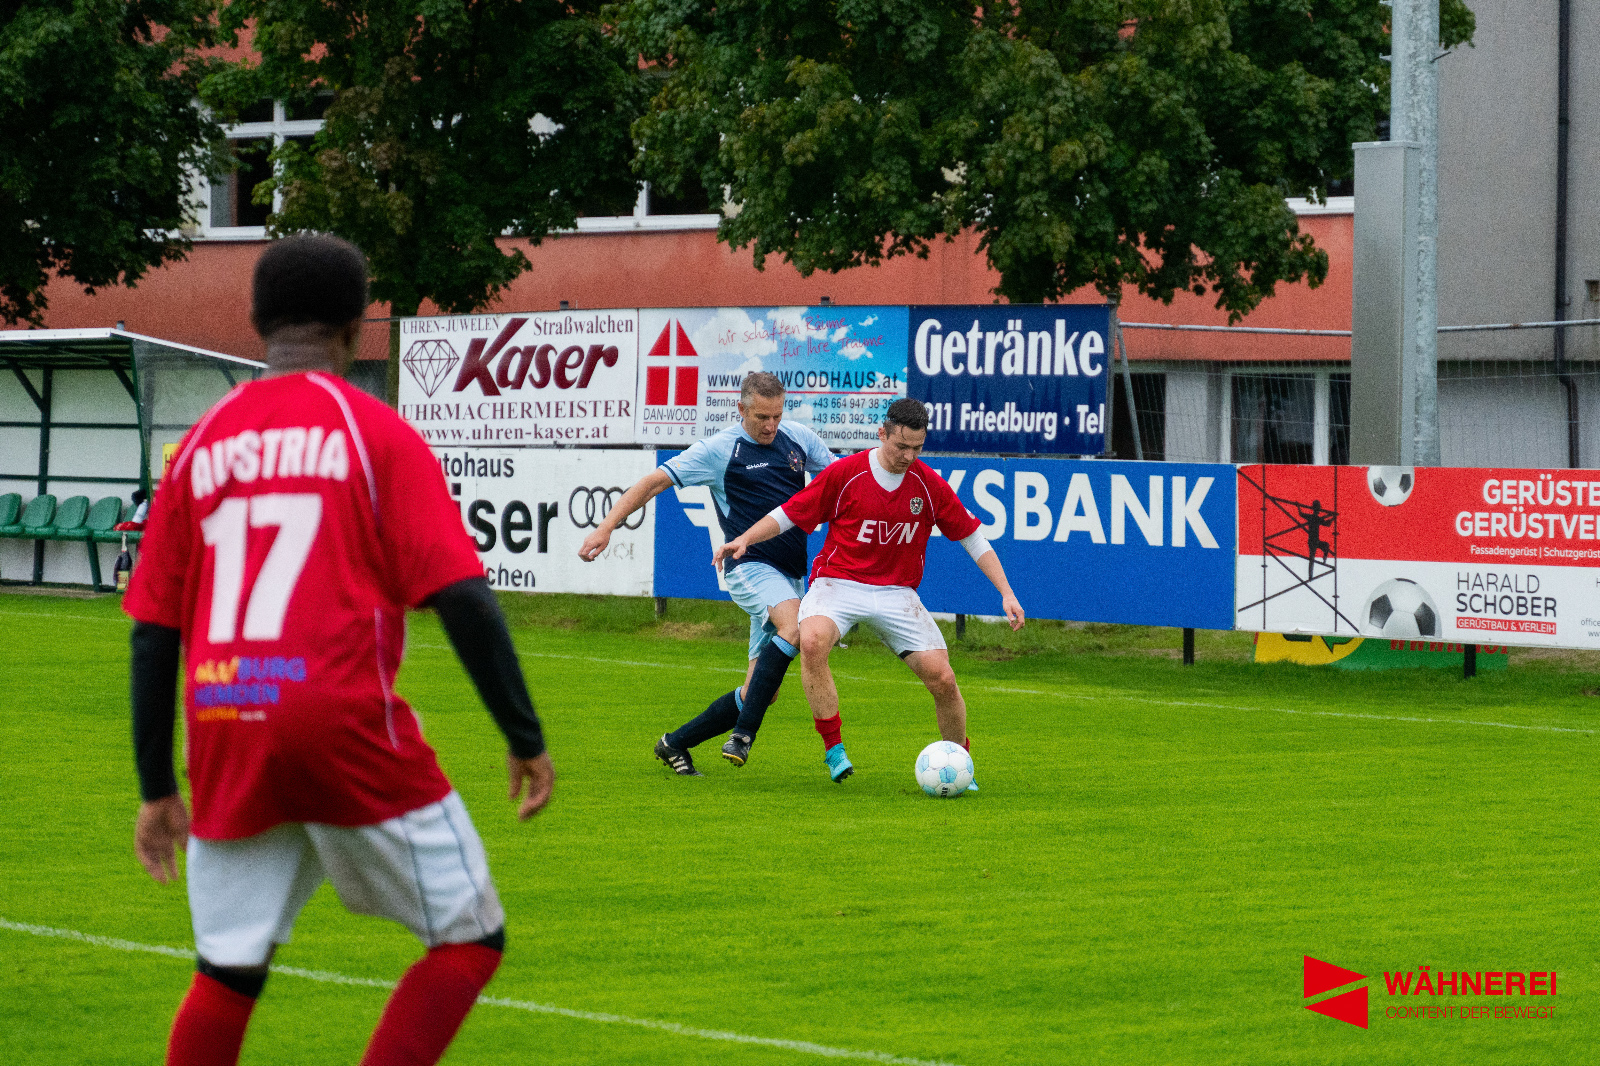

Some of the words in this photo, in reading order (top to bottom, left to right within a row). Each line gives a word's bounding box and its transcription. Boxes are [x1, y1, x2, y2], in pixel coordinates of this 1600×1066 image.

[403, 317, 500, 334] UHREN-JUWELEN
[533, 315, 633, 336] Straßwalchen
[452, 317, 618, 396] Kaser
[781, 341, 802, 364] für
[914, 317, 1104, 376] Getränke
[707, 371, 898, 389] wwwWOODHAUS.at
[402, 400, 631, 421] UHRMACHERMEISTER
[706, 396, 740, 407] Bernhar
[783, 399, 803, 410] rger
[812, 398, 829, 409] +43
[831, 398, 847, 409] 664
[850, 398, 866, 409] 947
[868, 398, 879, 409] 38
[643, 408, 697, 422] DAN-WOOD
[705, 411, 728, 422] Josef
[731, 411, 741, 422] Fe
[812, 413, 828, 424] +43
[830, 413, 846, 424] 650
[849, 413, 865, 424] 392
[867, 413, 879, 424] 52
[923, 402, 952, 430] 211
[960, 402, 1057, 441] Friedburg
[1076, 403, 1104, 434] Tel
[421, 423, 609, 441] www.uhren-kaser.at
[642, 426, 697, 436] HOUSE
[190, 426, 349, 500] AUSTRIA
[437, 451, 515, 478] tohaus
[856, 519, 920, 545] EVN
[1470, 544, 1538, 558] Fassadengerüst
[200, 492, 323, 645] 17
[481, 562, 536, 588] chen
[1457, 571, 1540, 593] HARALD
[1456, 593, 1557, 617] SCHOBER
[1457, 617, 1510, 631] GERÜSTBAU
[1518, 622, 1556, 634] VERLEIH
